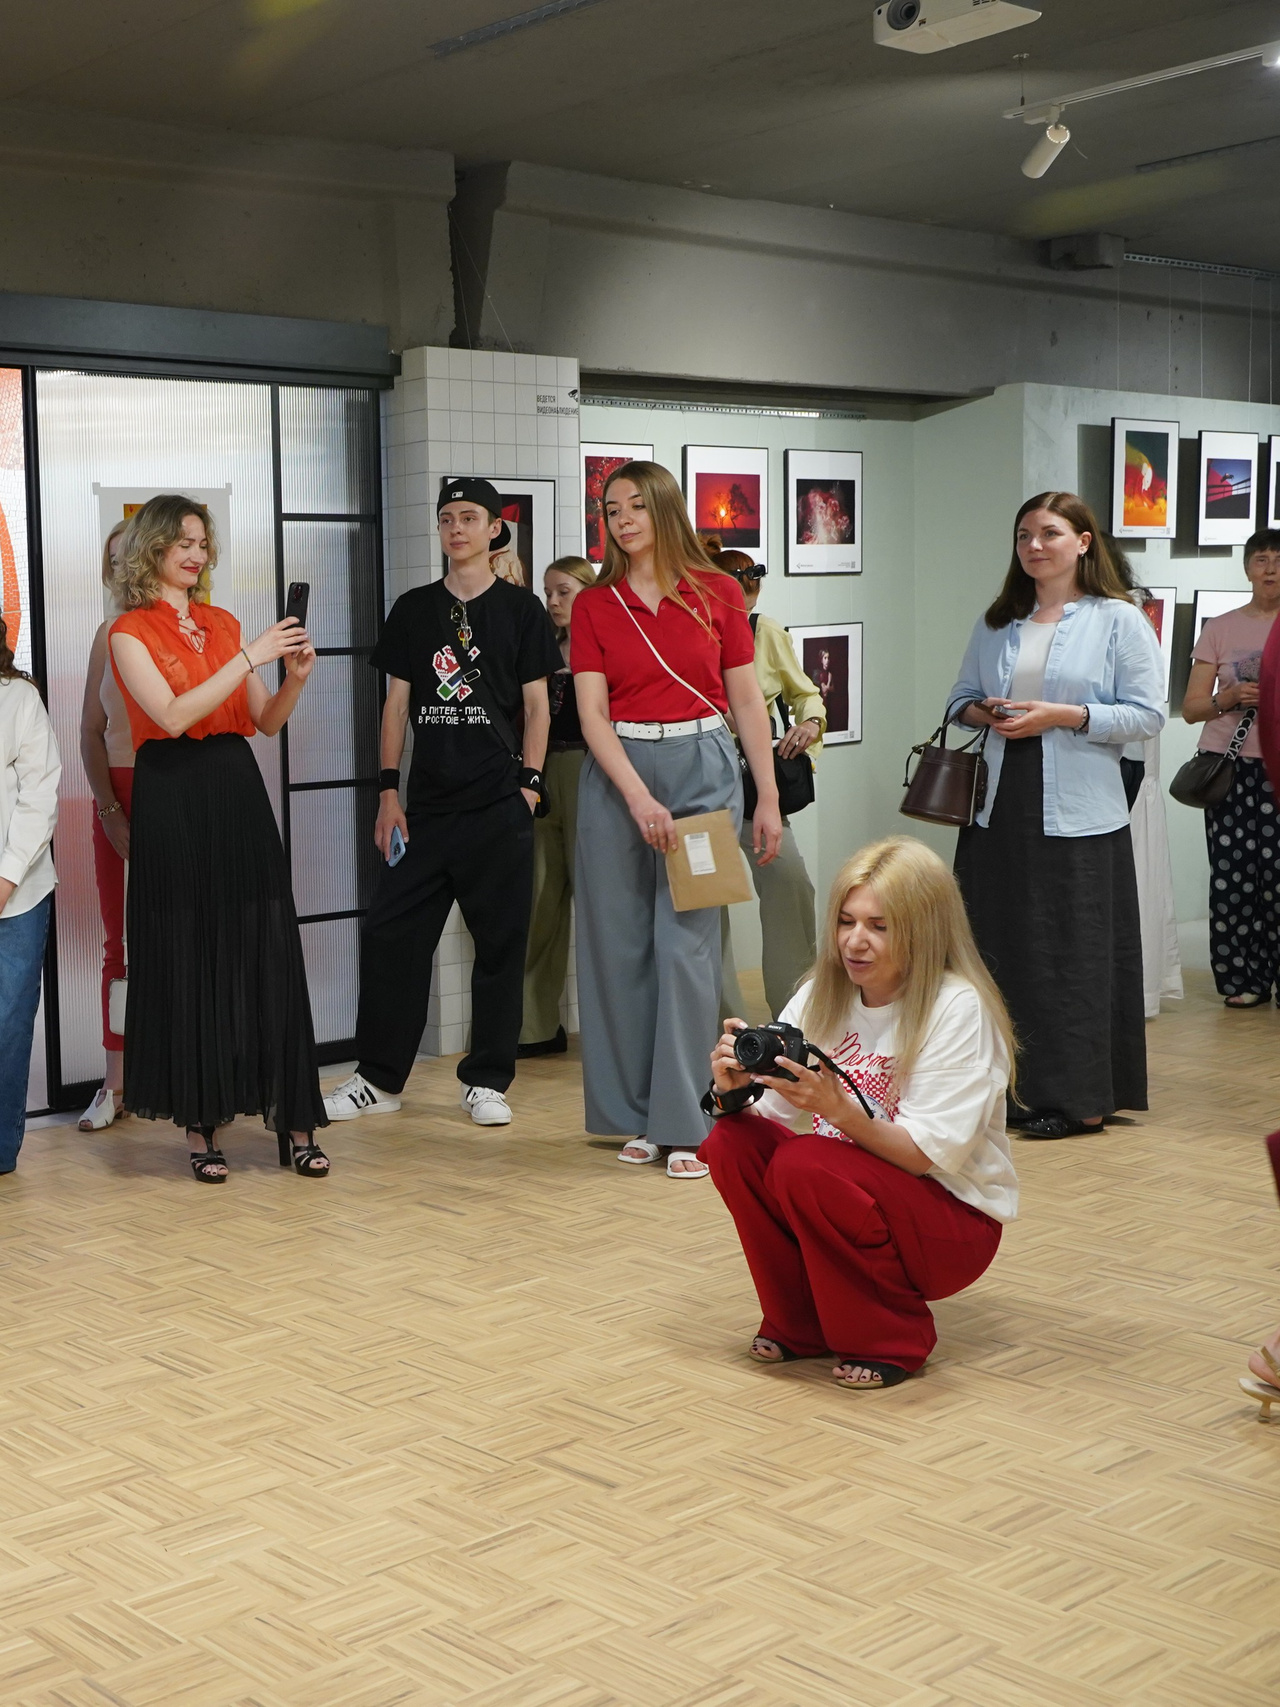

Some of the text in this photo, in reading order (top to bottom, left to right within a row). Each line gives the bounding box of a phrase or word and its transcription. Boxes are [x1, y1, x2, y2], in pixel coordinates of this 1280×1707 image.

[421, 706, 427, 714] В
[464, 706, 487, 715] ПИТЬ
[418, 715, 423, 724] В
[467, 715, 491, 724] ЖИТЬ
